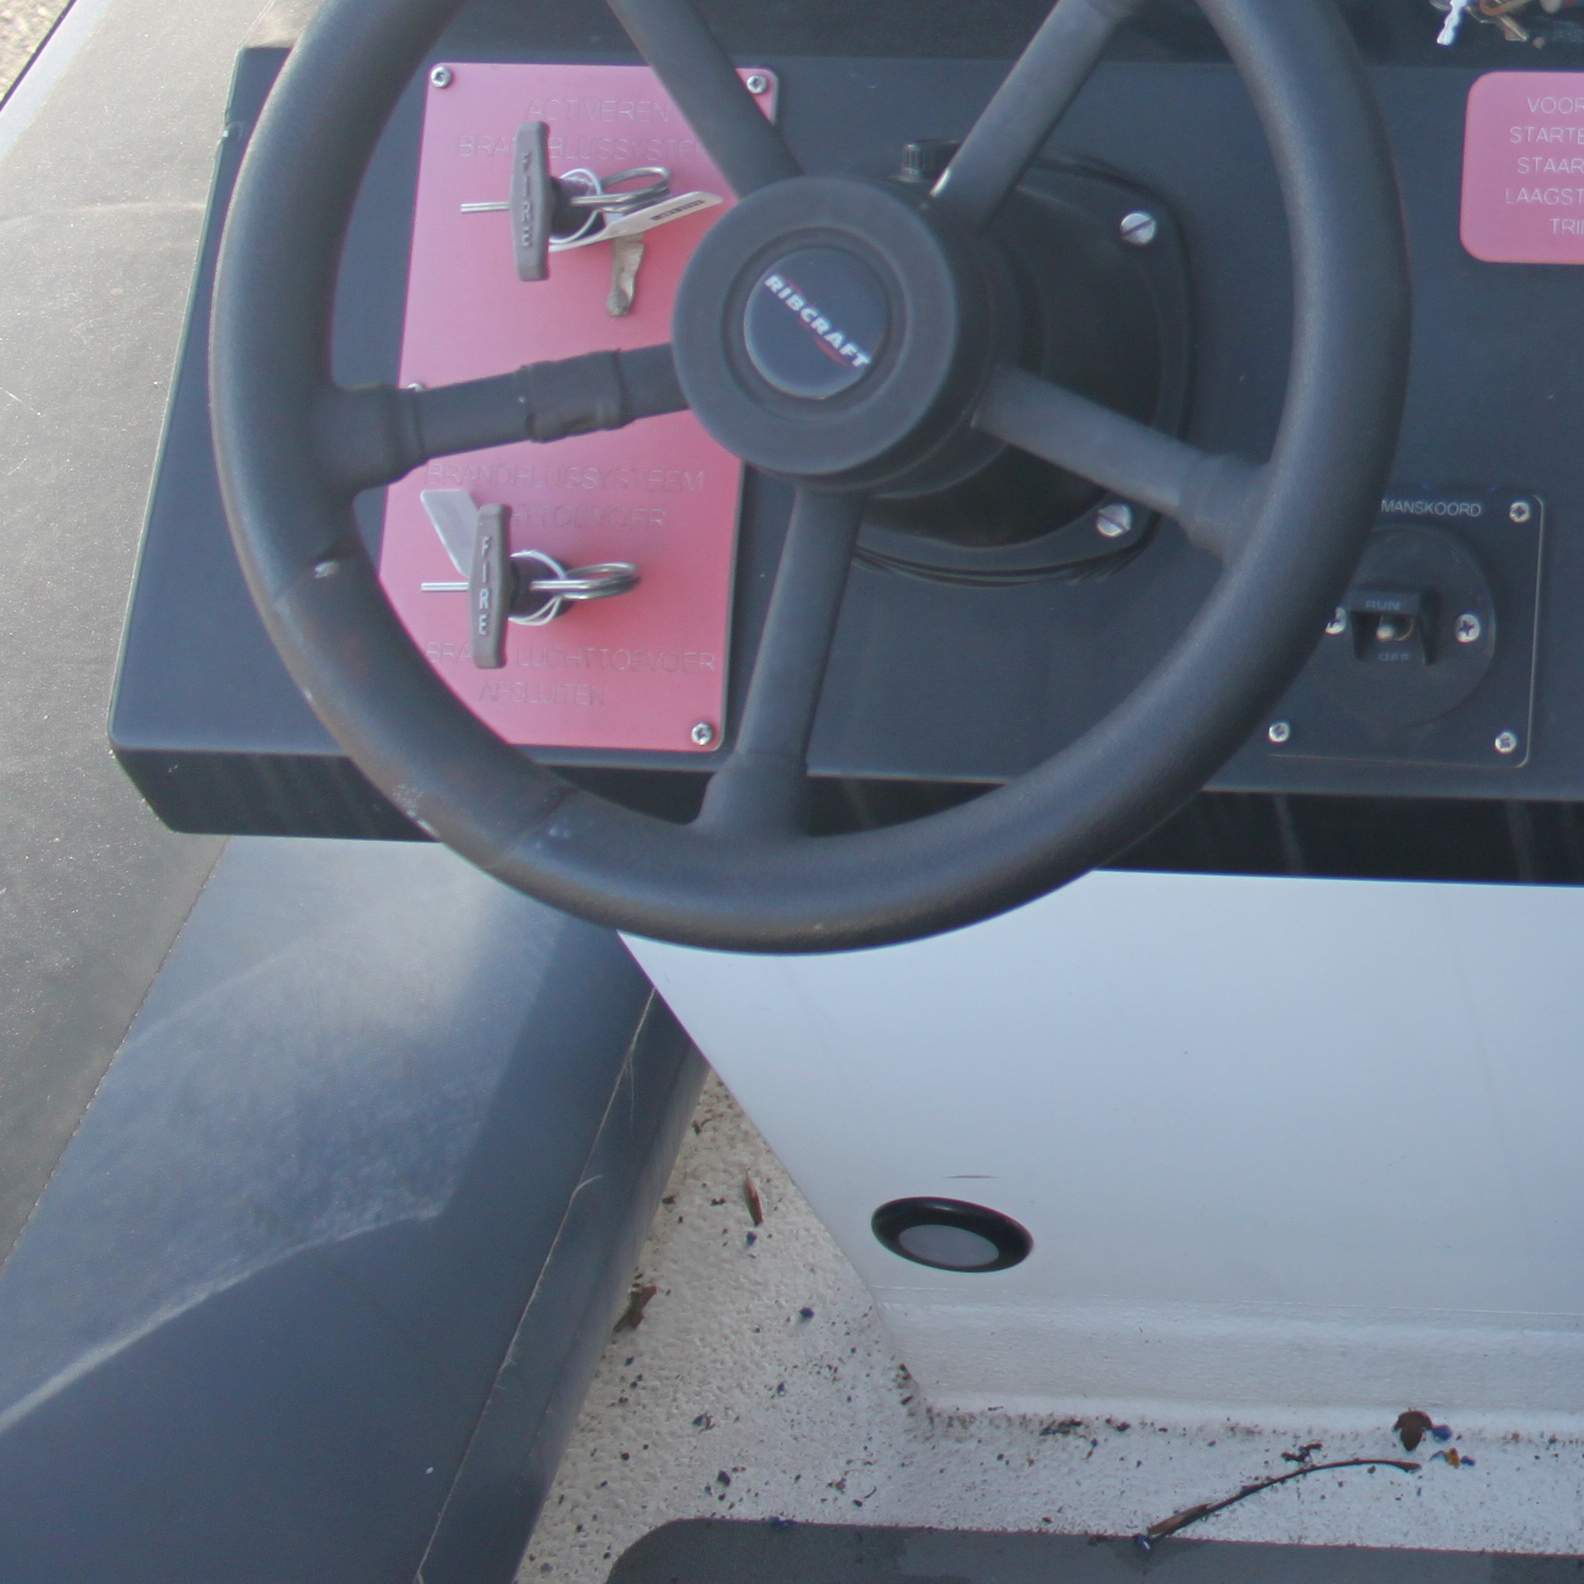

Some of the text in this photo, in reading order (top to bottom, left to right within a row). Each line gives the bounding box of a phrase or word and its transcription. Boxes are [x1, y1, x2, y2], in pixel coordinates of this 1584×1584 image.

[764, 273, 871, 368] RIBCRAFT
[1380, 498, 1482, 518] MANSKOORD
[477, 535, 492, 636] FIRE
[1364, 598, 1399, 611] RUN
